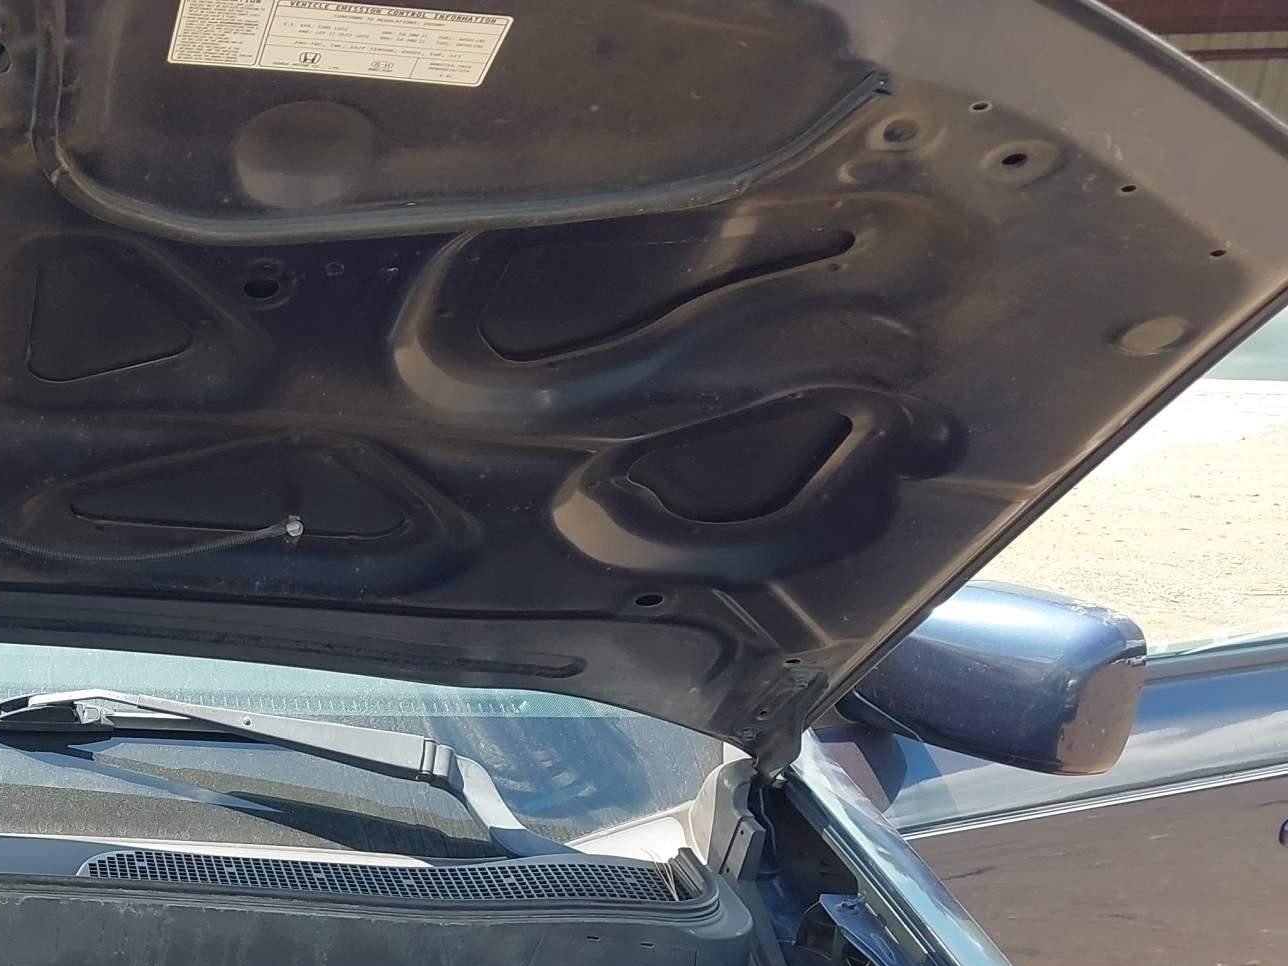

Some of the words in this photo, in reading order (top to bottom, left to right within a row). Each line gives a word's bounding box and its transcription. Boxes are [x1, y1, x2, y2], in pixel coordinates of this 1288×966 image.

[290, 1, 328, 10] VEHICLE
[335, 5, 382, 15] EMISSION
[387, 9, 426, 18] CONTROL
[434, 13, 497, 24] INFORMATION
